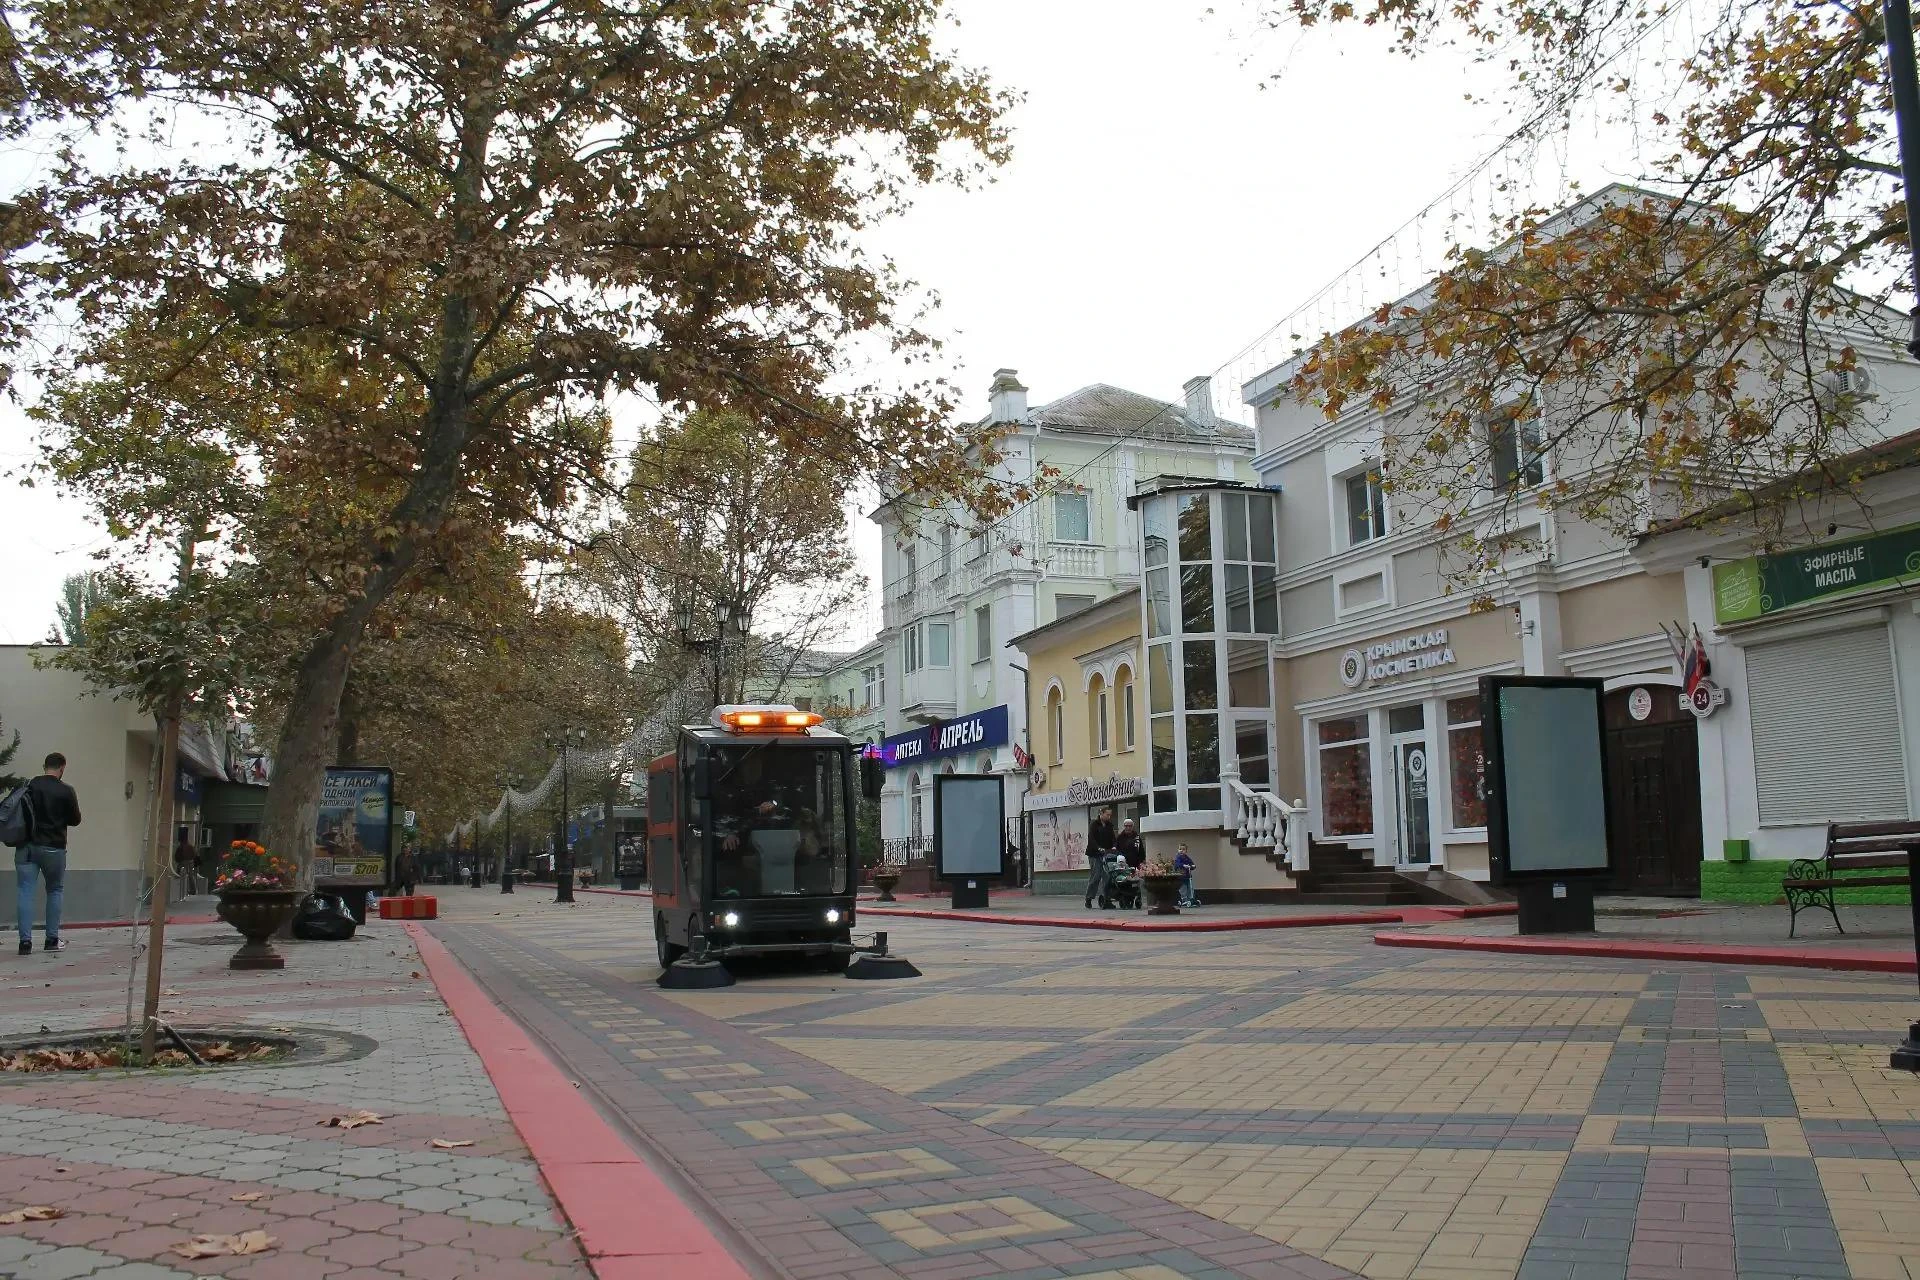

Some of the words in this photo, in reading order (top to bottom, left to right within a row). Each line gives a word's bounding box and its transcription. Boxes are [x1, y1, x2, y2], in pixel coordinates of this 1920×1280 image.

[1804, 546, 1865, 573] ЭФИРНЫЕ
[1815, 567, 1857, 588] МАСЛА
[1366, 628, 1448, 661] КРЫМСКАЯ
[1367, 648, 1457, 681] КОСМЕТИКА
[1696, 692, 1708, 705] 24
[894, 738, 922, 761] АПТЕКА
[939, 718, 984, 751] АПРЕЛЬ
